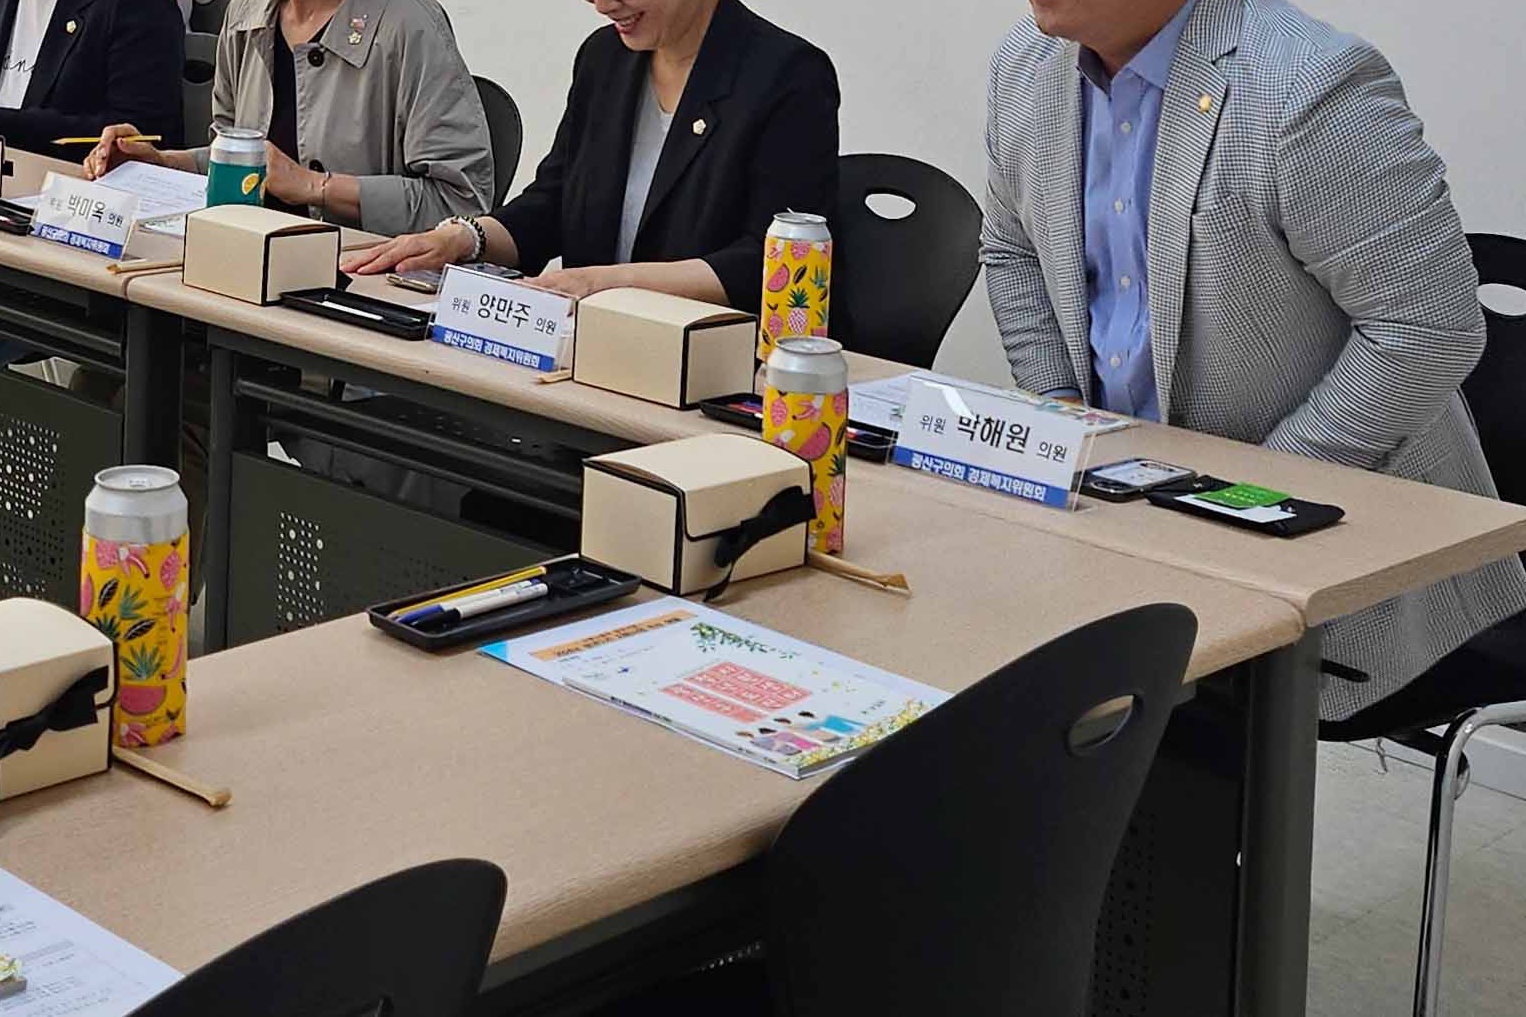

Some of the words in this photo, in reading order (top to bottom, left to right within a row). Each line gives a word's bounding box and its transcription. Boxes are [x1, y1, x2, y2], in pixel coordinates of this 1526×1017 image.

[451, 296, 472, 315] 위원
[477, 293, 531, 329] 양만주
[534, 317, 557, 336] 의원
[920, 414, 947, 435] 위원
[1036, 440, 1068, 463] 의원
